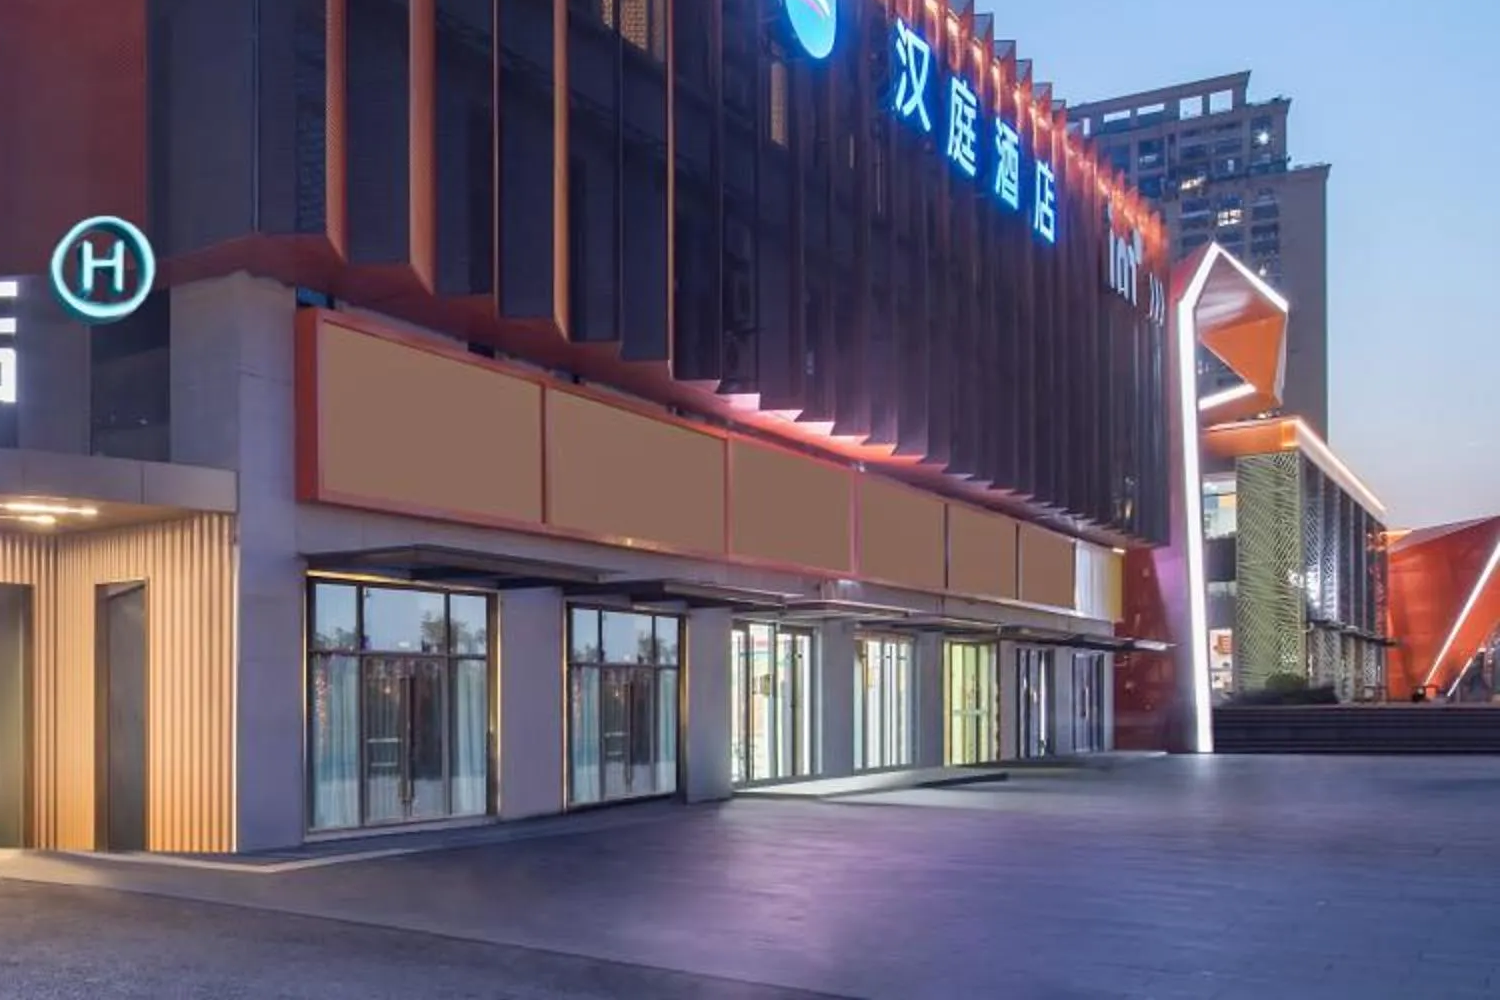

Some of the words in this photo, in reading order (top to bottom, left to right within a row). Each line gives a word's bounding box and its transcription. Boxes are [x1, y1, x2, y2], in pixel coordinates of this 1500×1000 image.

[895, 17, 1056, 244] 汉庭酒店
[80, 241, 125, 292] H
